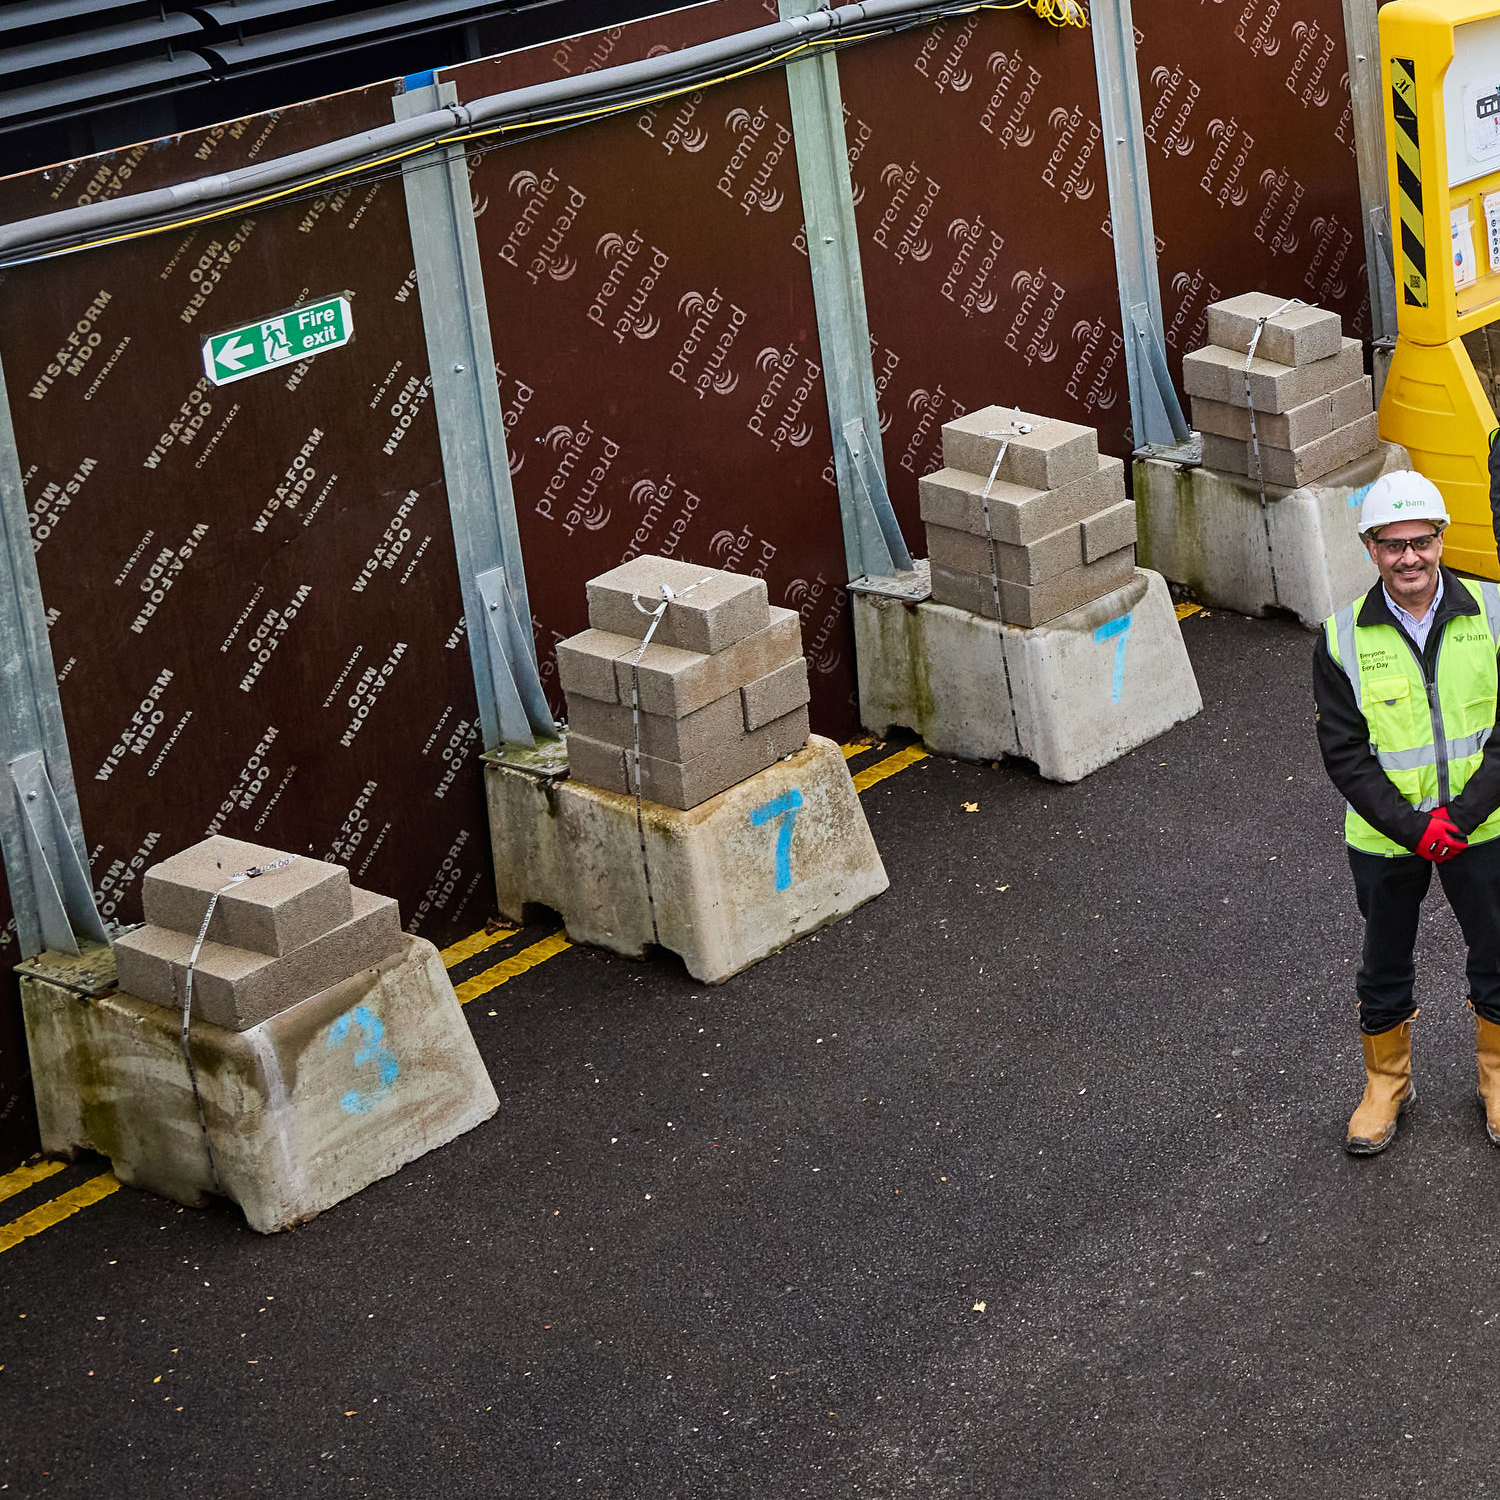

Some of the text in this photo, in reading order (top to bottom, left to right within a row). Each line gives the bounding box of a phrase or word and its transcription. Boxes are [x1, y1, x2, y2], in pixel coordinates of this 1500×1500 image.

[979, 49, 1024, 135] premier
[999, 65, 1043, 150] premier
[716, 105, 771, 198] premier
[739, 122, 792, 216] premier
[498, 167, 560, 267] premier
[525, 185, 587, 285] premier
[299, 307, 335, 331] Fire
[586, 229, 645, 327] premier
[612, 246, 670, 344] premier
[1003, 265, 1048, 352] premier
[28, 289, 112, 401] WISA-FORM
[67, 332, 102, 377] MDO
[302, 326, 337, 349] exit
[1024, 282, 1066, 366] premier
[83, 335, 132, 401] CONTRACARA
[251, 427, 325, 534] WISA-FORM
[284, 466, 316, 509] MDO
[302, 473, 338, 527] RÜCKSEITE
[534, 419, 594, 521] premier
[1405, 499, 1425, 507] bam
[351, 489, 420, 594] WISA-FORM
[382, 528, 412, 571] MDO
[400, 535, 432, 585] BACK SIDE
[239, 583, 312, 694] WISA-FORM
[1094, 612, 1132, 704] 7
[1466, 632, 1488, 642] bam
[751, 788, 801, 891] 7
